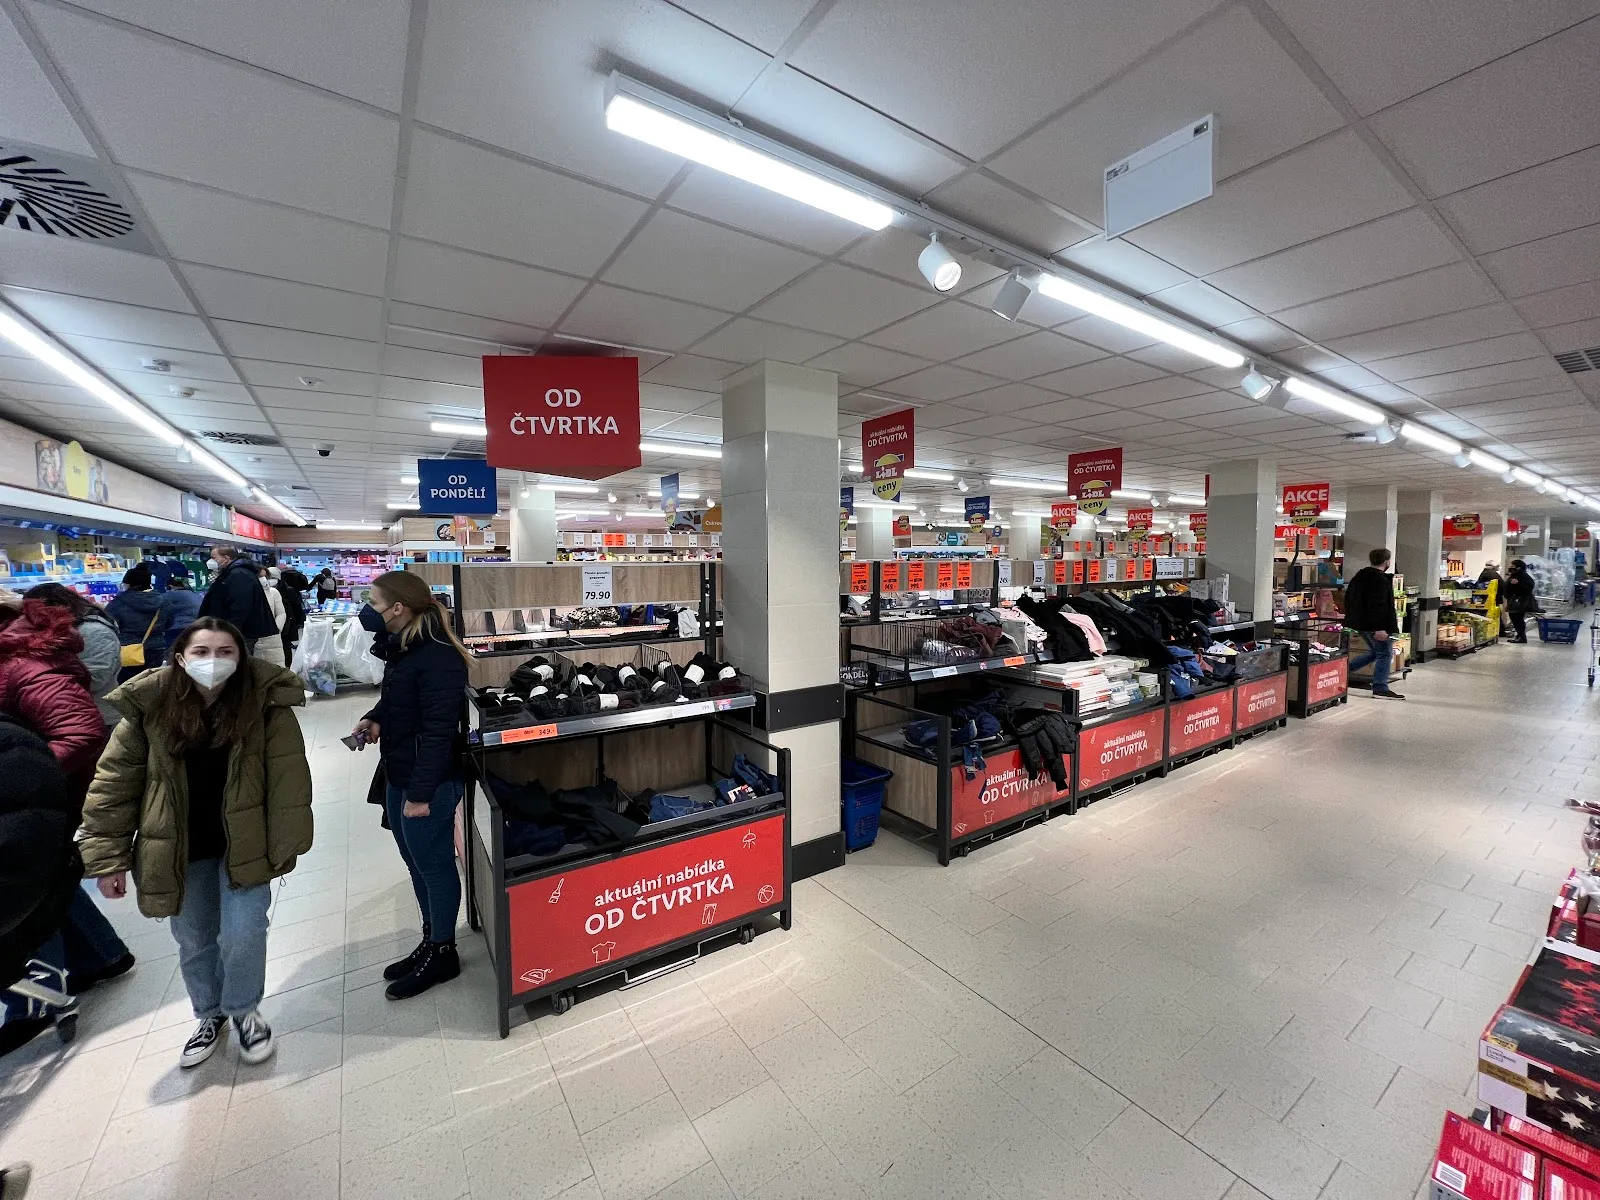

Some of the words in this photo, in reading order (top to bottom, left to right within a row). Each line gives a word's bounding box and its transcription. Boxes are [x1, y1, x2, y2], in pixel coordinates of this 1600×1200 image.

[545, 389, 581, 407] OD
[510, 412, 619, 435] ČTVRTKA
[868, 438, 878, 447] OD
[878, 431, 908, 445] ČTVRTKA
[1074, 467, 1084, 475] OD
[1085, 464, 1115, 473] ČTVRTKA
[448, 475, 467, 485] OD
[878, 480, 897, 493] ceny
[430, 487, 486, 499] PONDĚLÍ
[1284, 489, 1328, 503] AKCE
[1084, 500, 1103, 509] ceny
[1052, 507, 1077, 517] AKCE
[1128, 512, 1152, 521] AKCE
[1191, 516, 1207, 524] AKC
[1283, 527, 1310, 537] AKCE
[585, 591, 611, 600] 79.90
[1184, 723, 1194, 735] OD
[1194, 714, 1220, 732] ČTVRTKA
[1103, 735, 1125, 749] aktuální
[1125, 729, 1146, 742] nabídka
[1100, 750, 1113, 764] OD
[1114, 739, 1148, 760] ČTVRTKA
[986, 768, 1016, 786] aktuální
[981, 788, 999, 805] OD
[594, 873, 662, 907] aktuální
[666, 859, 726, 886] nabídka
[584, 907, 624, 935] OD
[631, 873, 735, 920] ČTVRTKA
